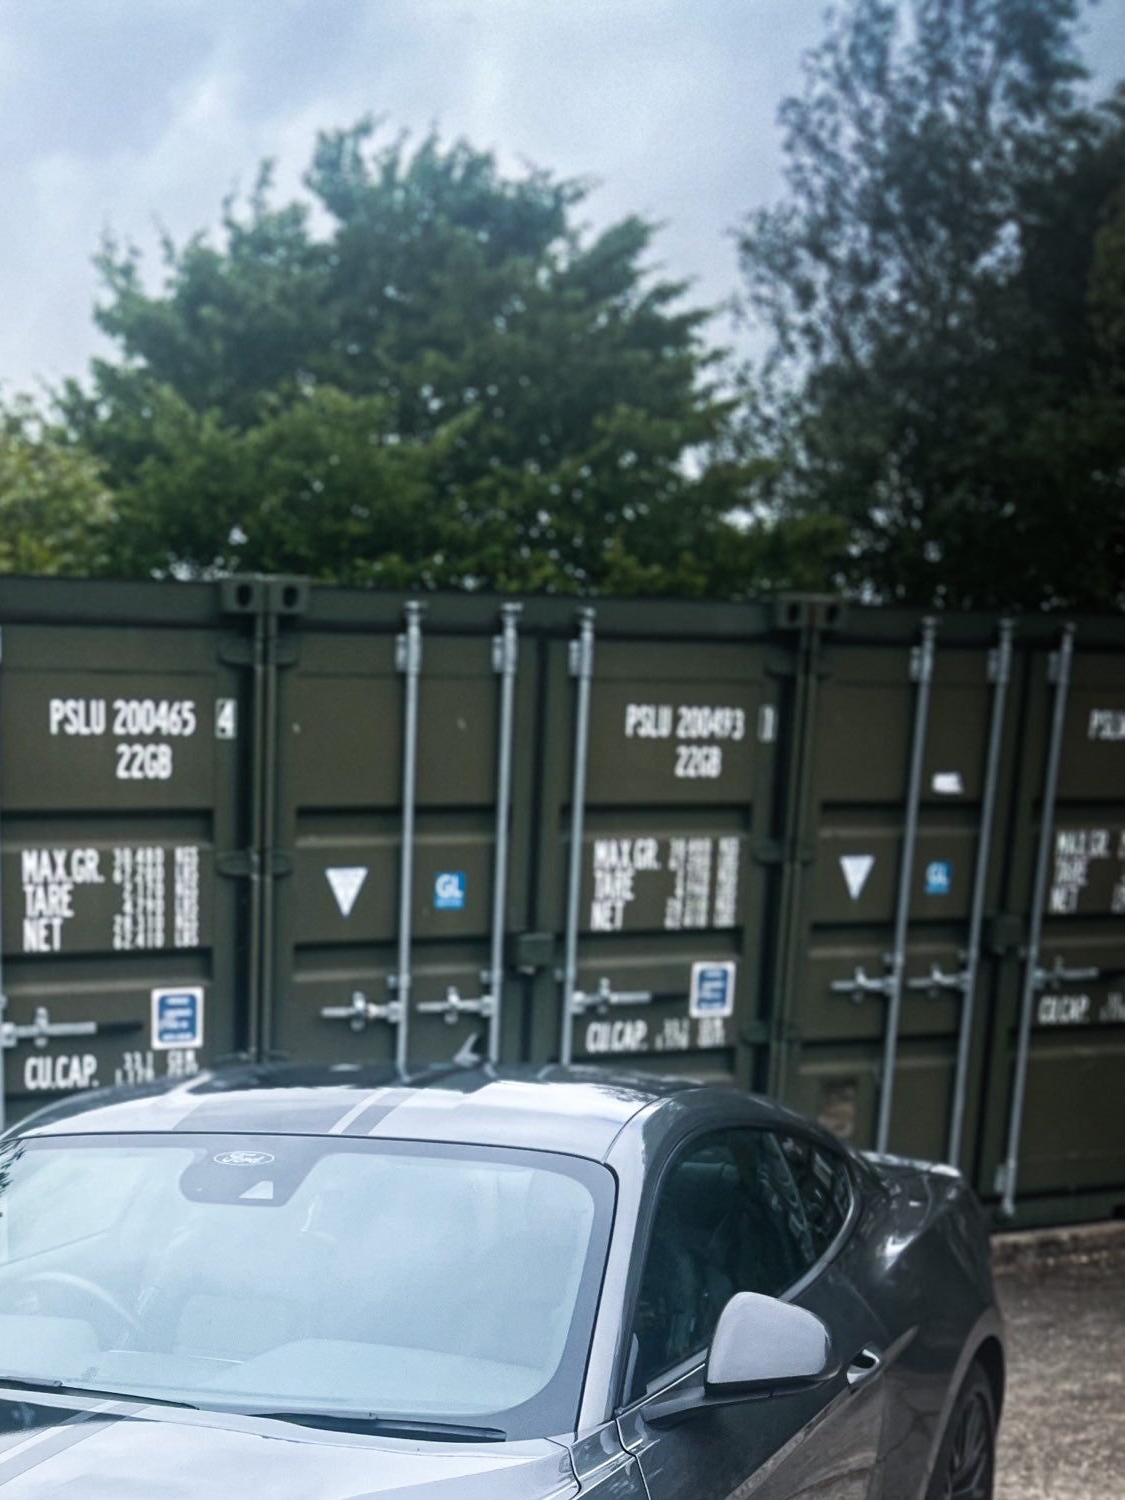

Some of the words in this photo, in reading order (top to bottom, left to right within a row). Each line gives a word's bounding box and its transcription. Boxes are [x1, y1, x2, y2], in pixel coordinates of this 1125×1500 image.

[49, 699, 106, 735] PSLU
[113, 699, 196, 736] 200465
[216, 699, 236, 738] 4
[626, 704, 673, 738] PSLU
[116, 743, 172, 779] 22GB
[23, 883, 74, 918] TARE
[435, 874, 463, 898] GL
[23, 917, 63, 953] NET
